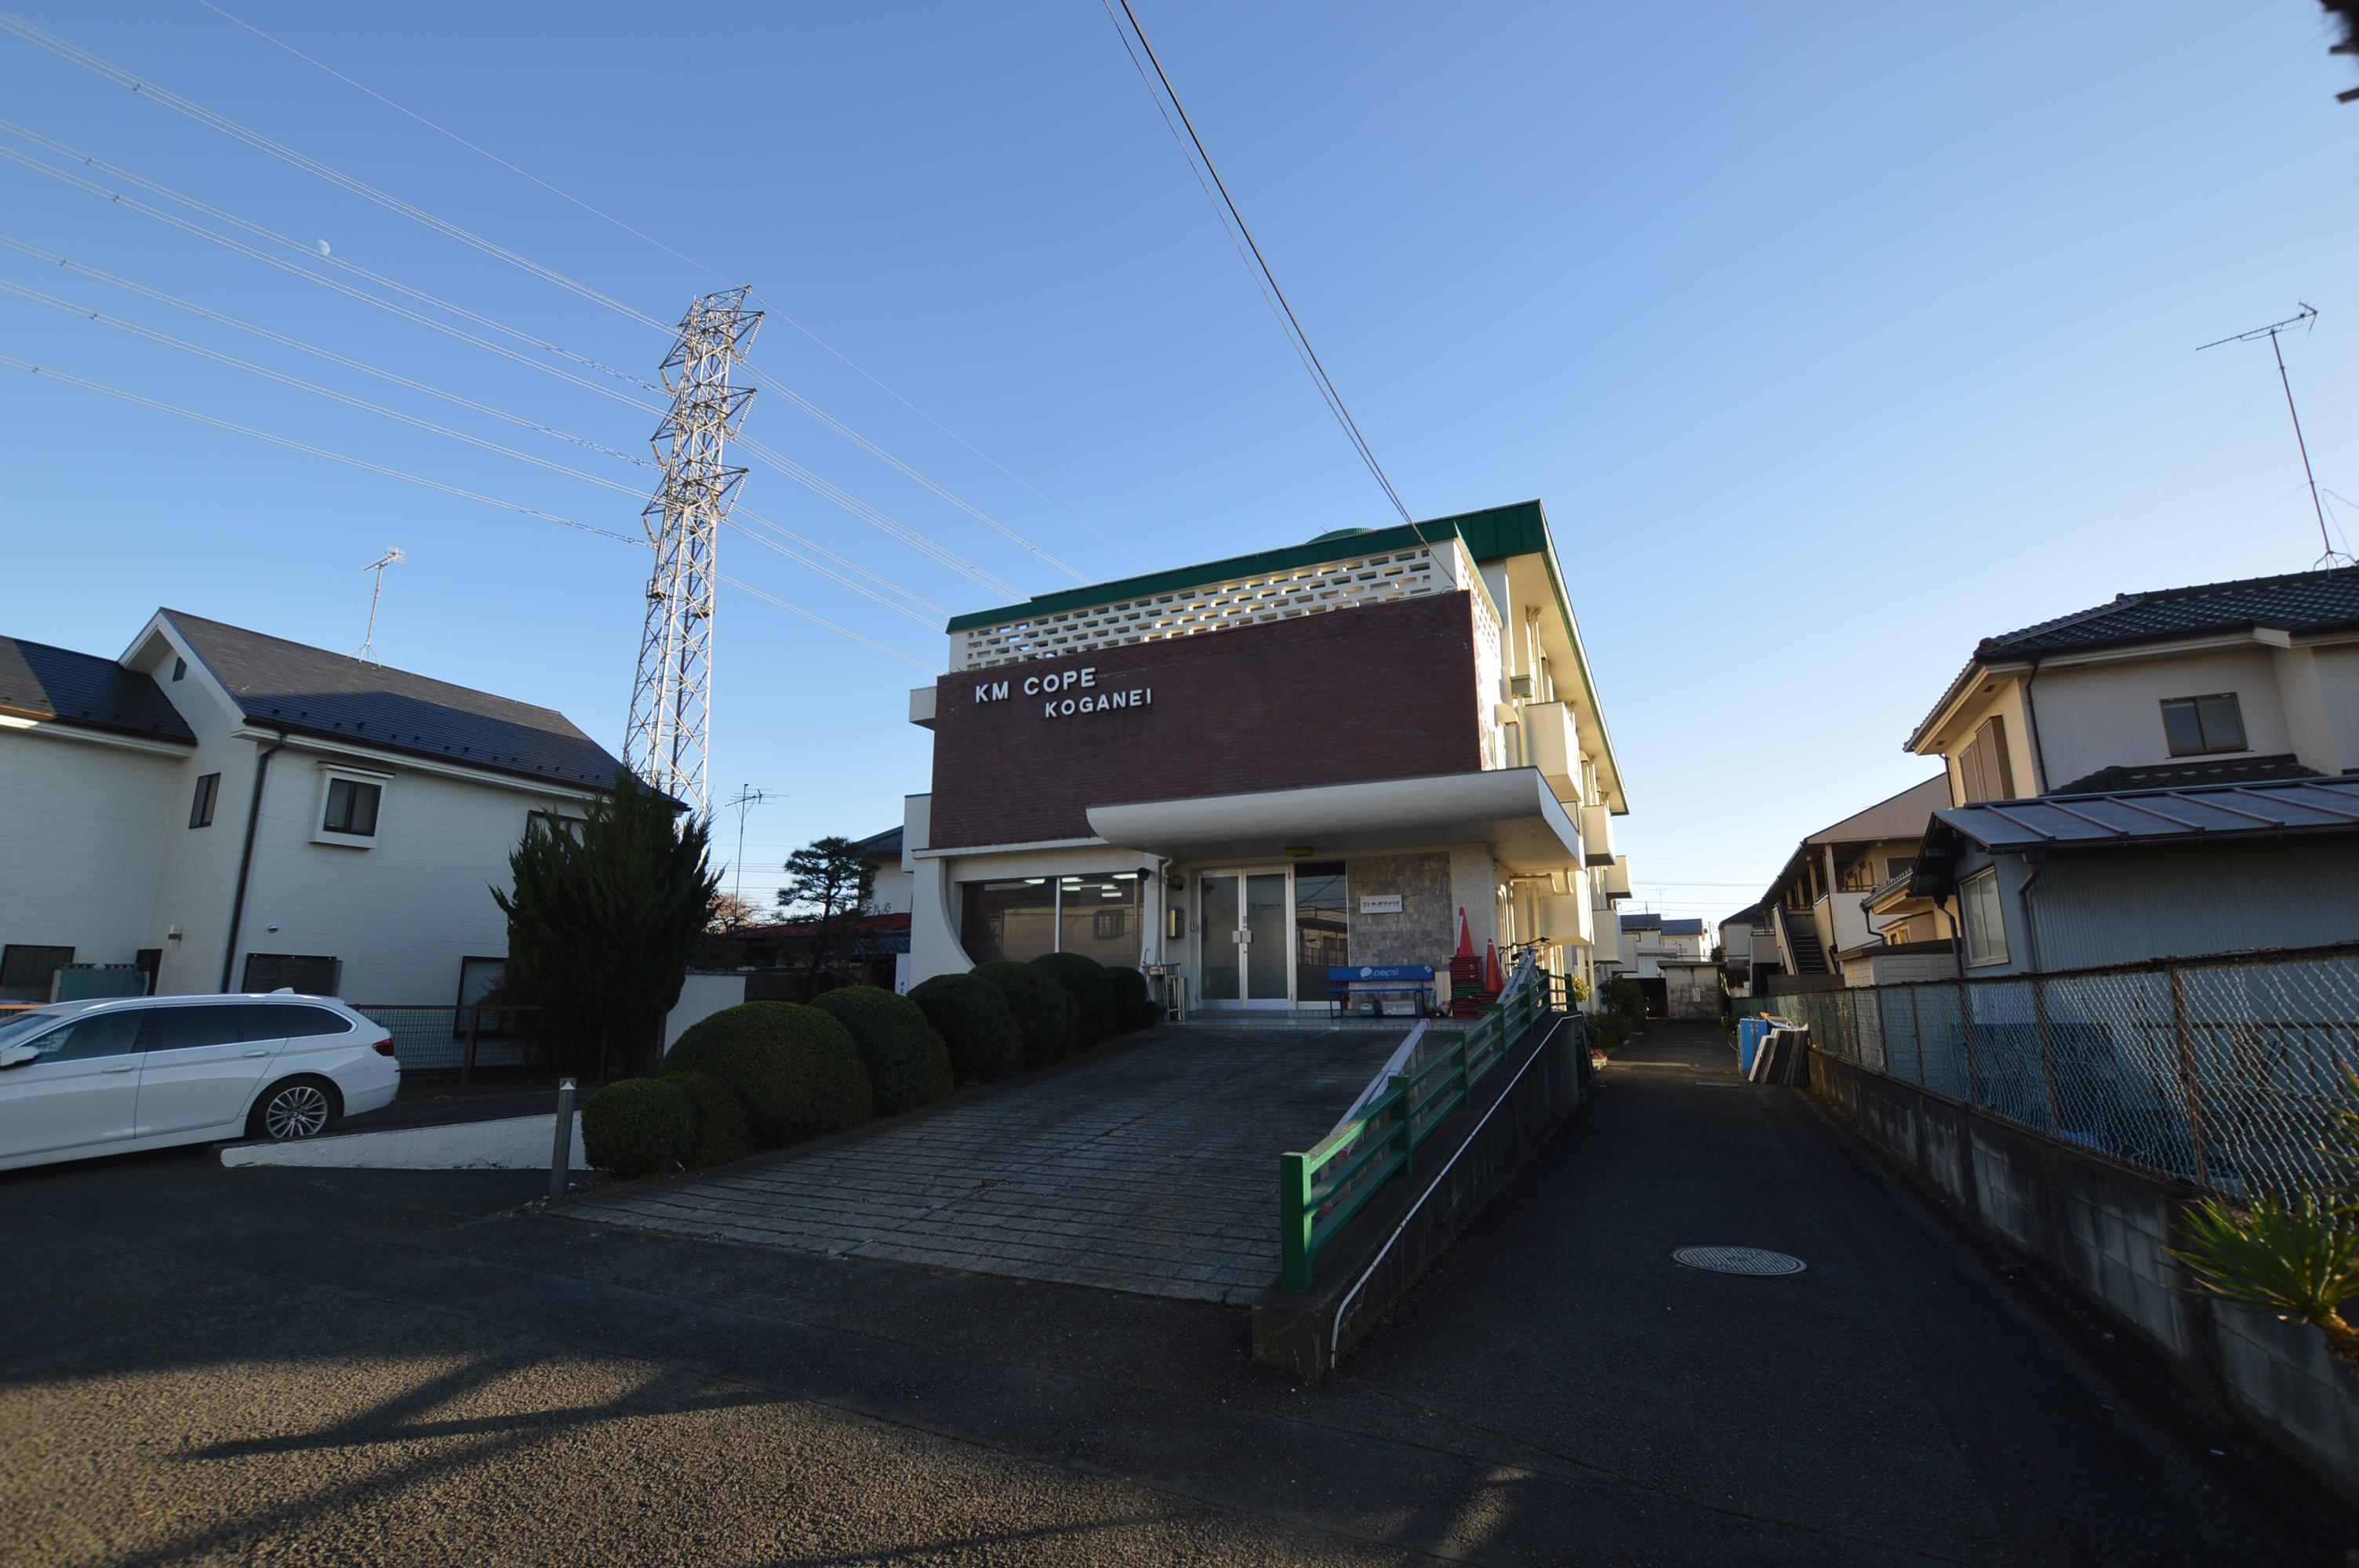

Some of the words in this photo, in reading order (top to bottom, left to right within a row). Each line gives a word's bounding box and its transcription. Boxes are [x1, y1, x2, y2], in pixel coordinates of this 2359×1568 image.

[976, 681, 1009, 702] KM
[1023, 667, 1096, 695] COPE
[1045, 688, 1152, 718] KOGANEI
[1373, 967, 1399, 978] pepsi
